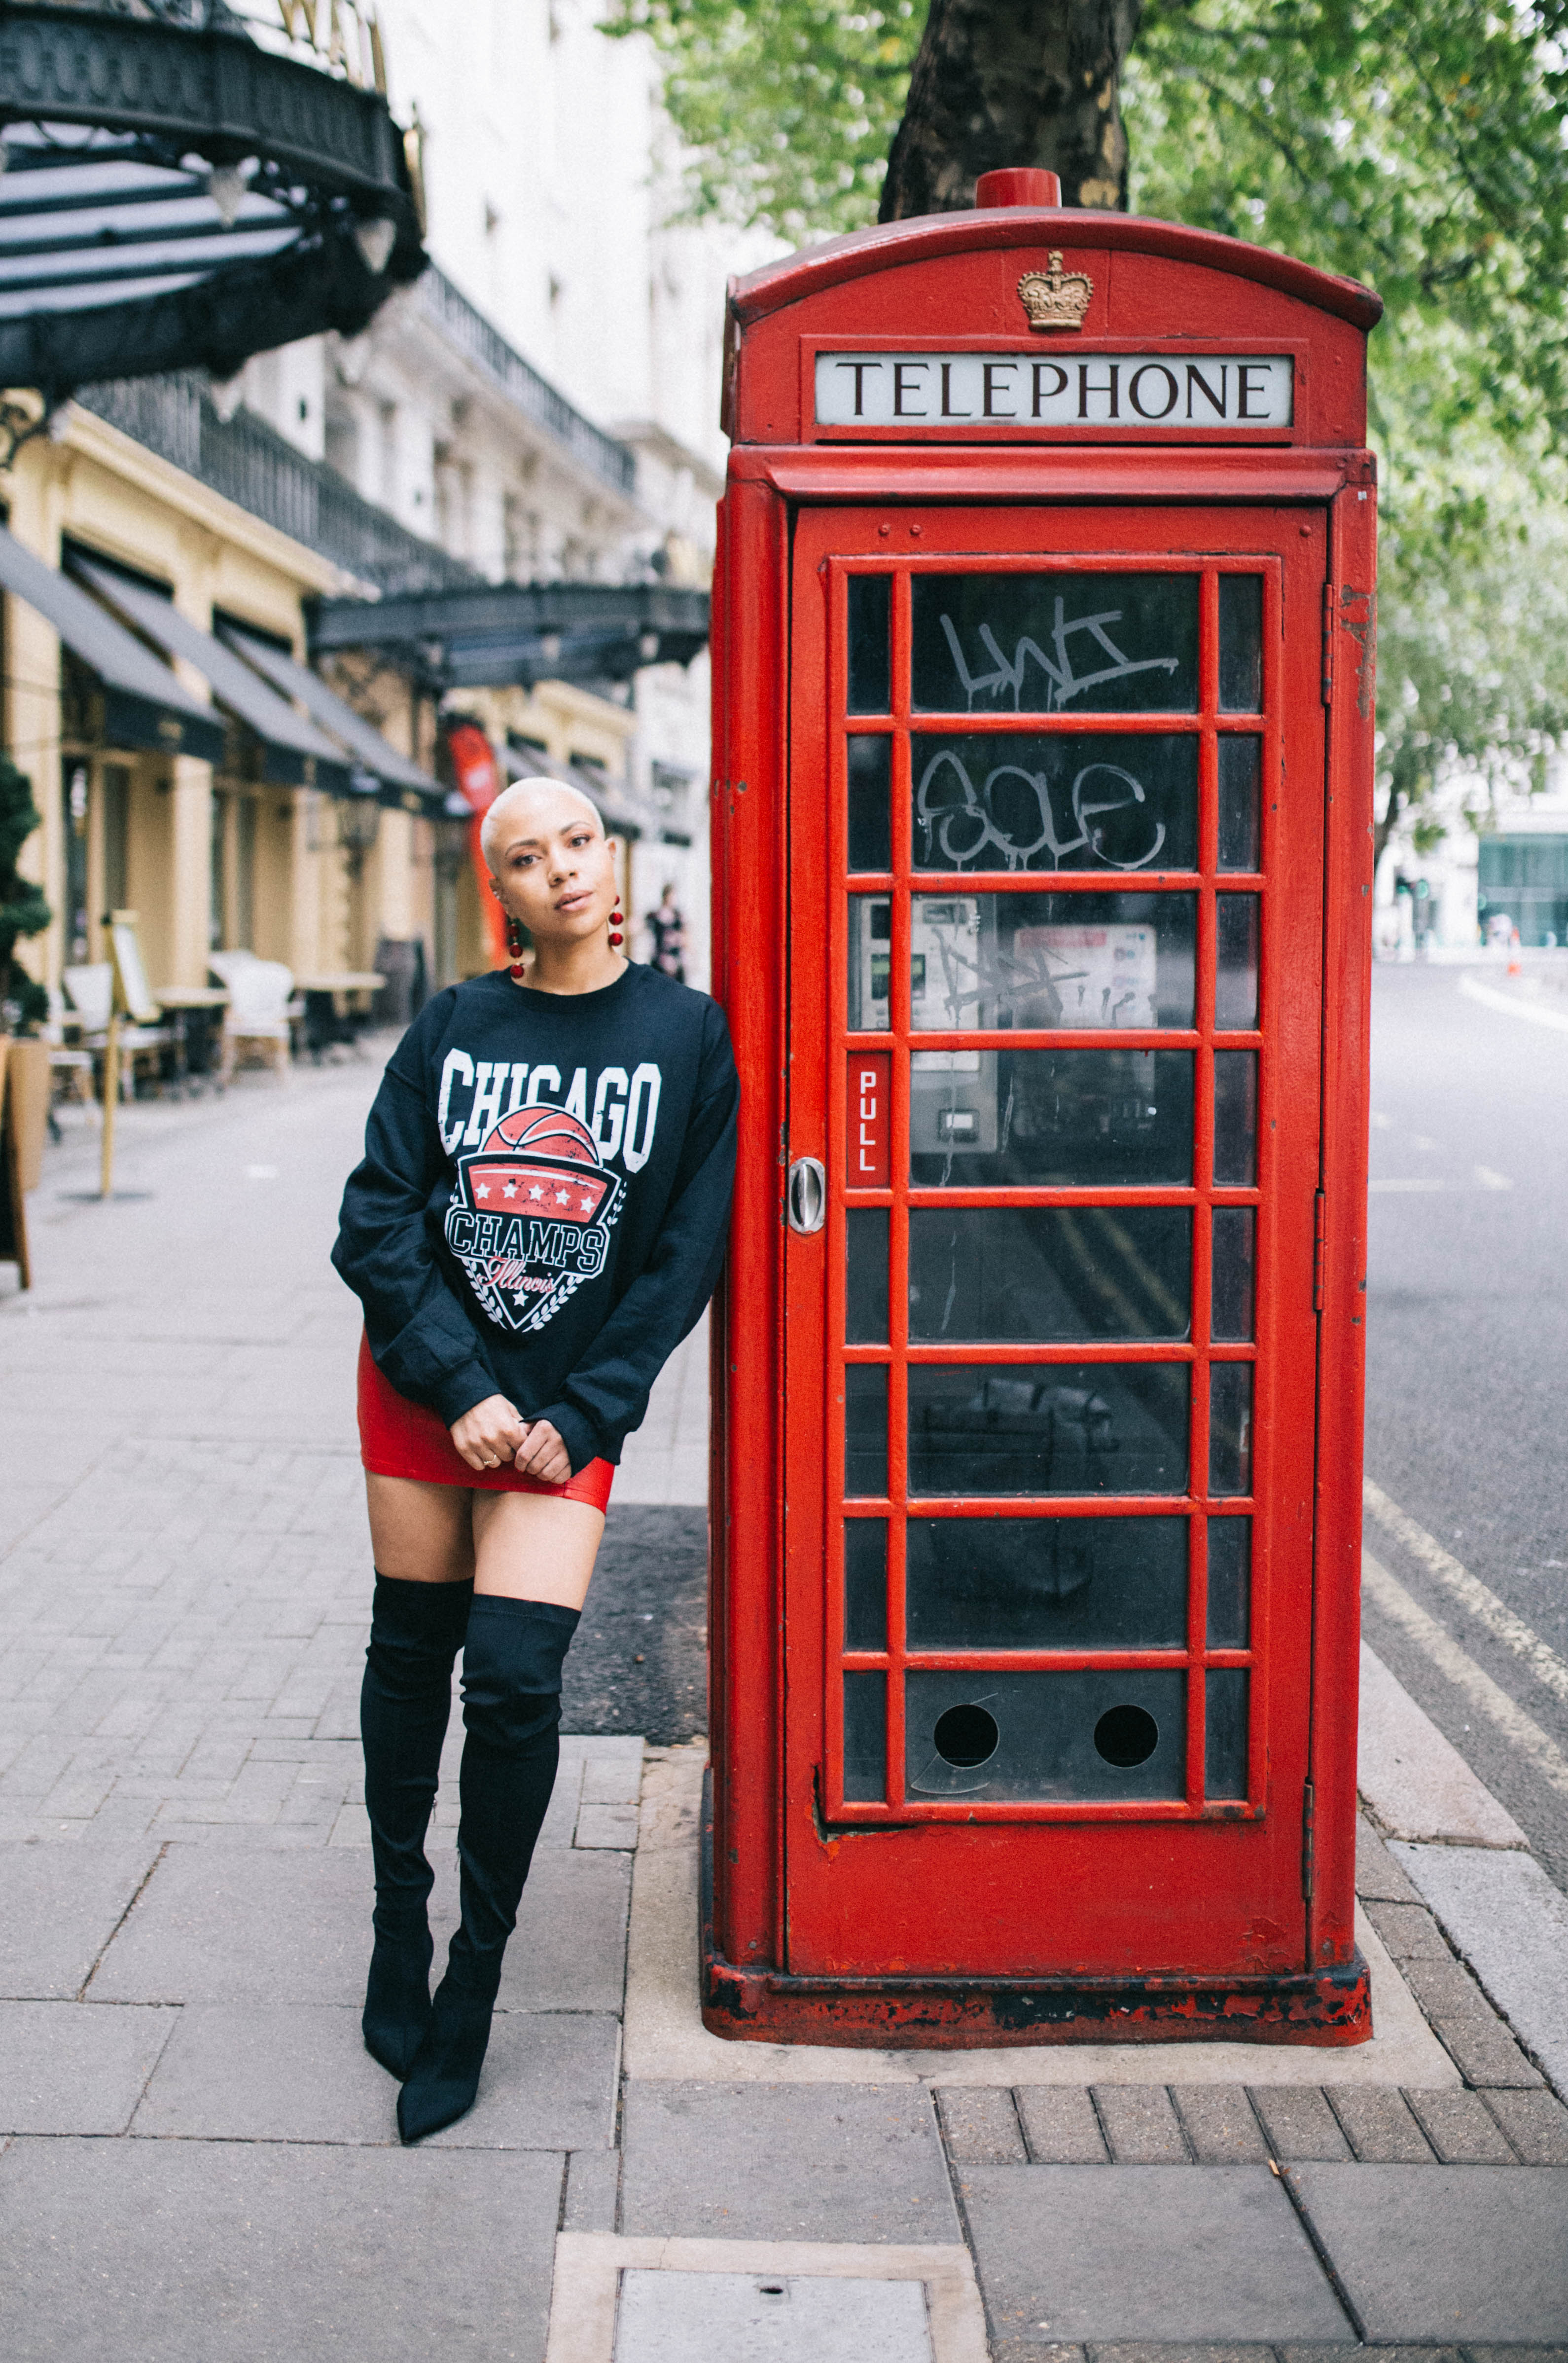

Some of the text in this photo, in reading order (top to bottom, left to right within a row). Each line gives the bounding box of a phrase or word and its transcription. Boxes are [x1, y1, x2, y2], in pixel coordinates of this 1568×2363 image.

[835, 362, 1273, 419] TELEPHONE
[438, 1048, 662, 1174] CHICAGO
[859, 1071, 877, 1171] PULL
[449, 1211, 606, 1272] CHAMPS
[477, 1256, 557, 1294] Illinois
